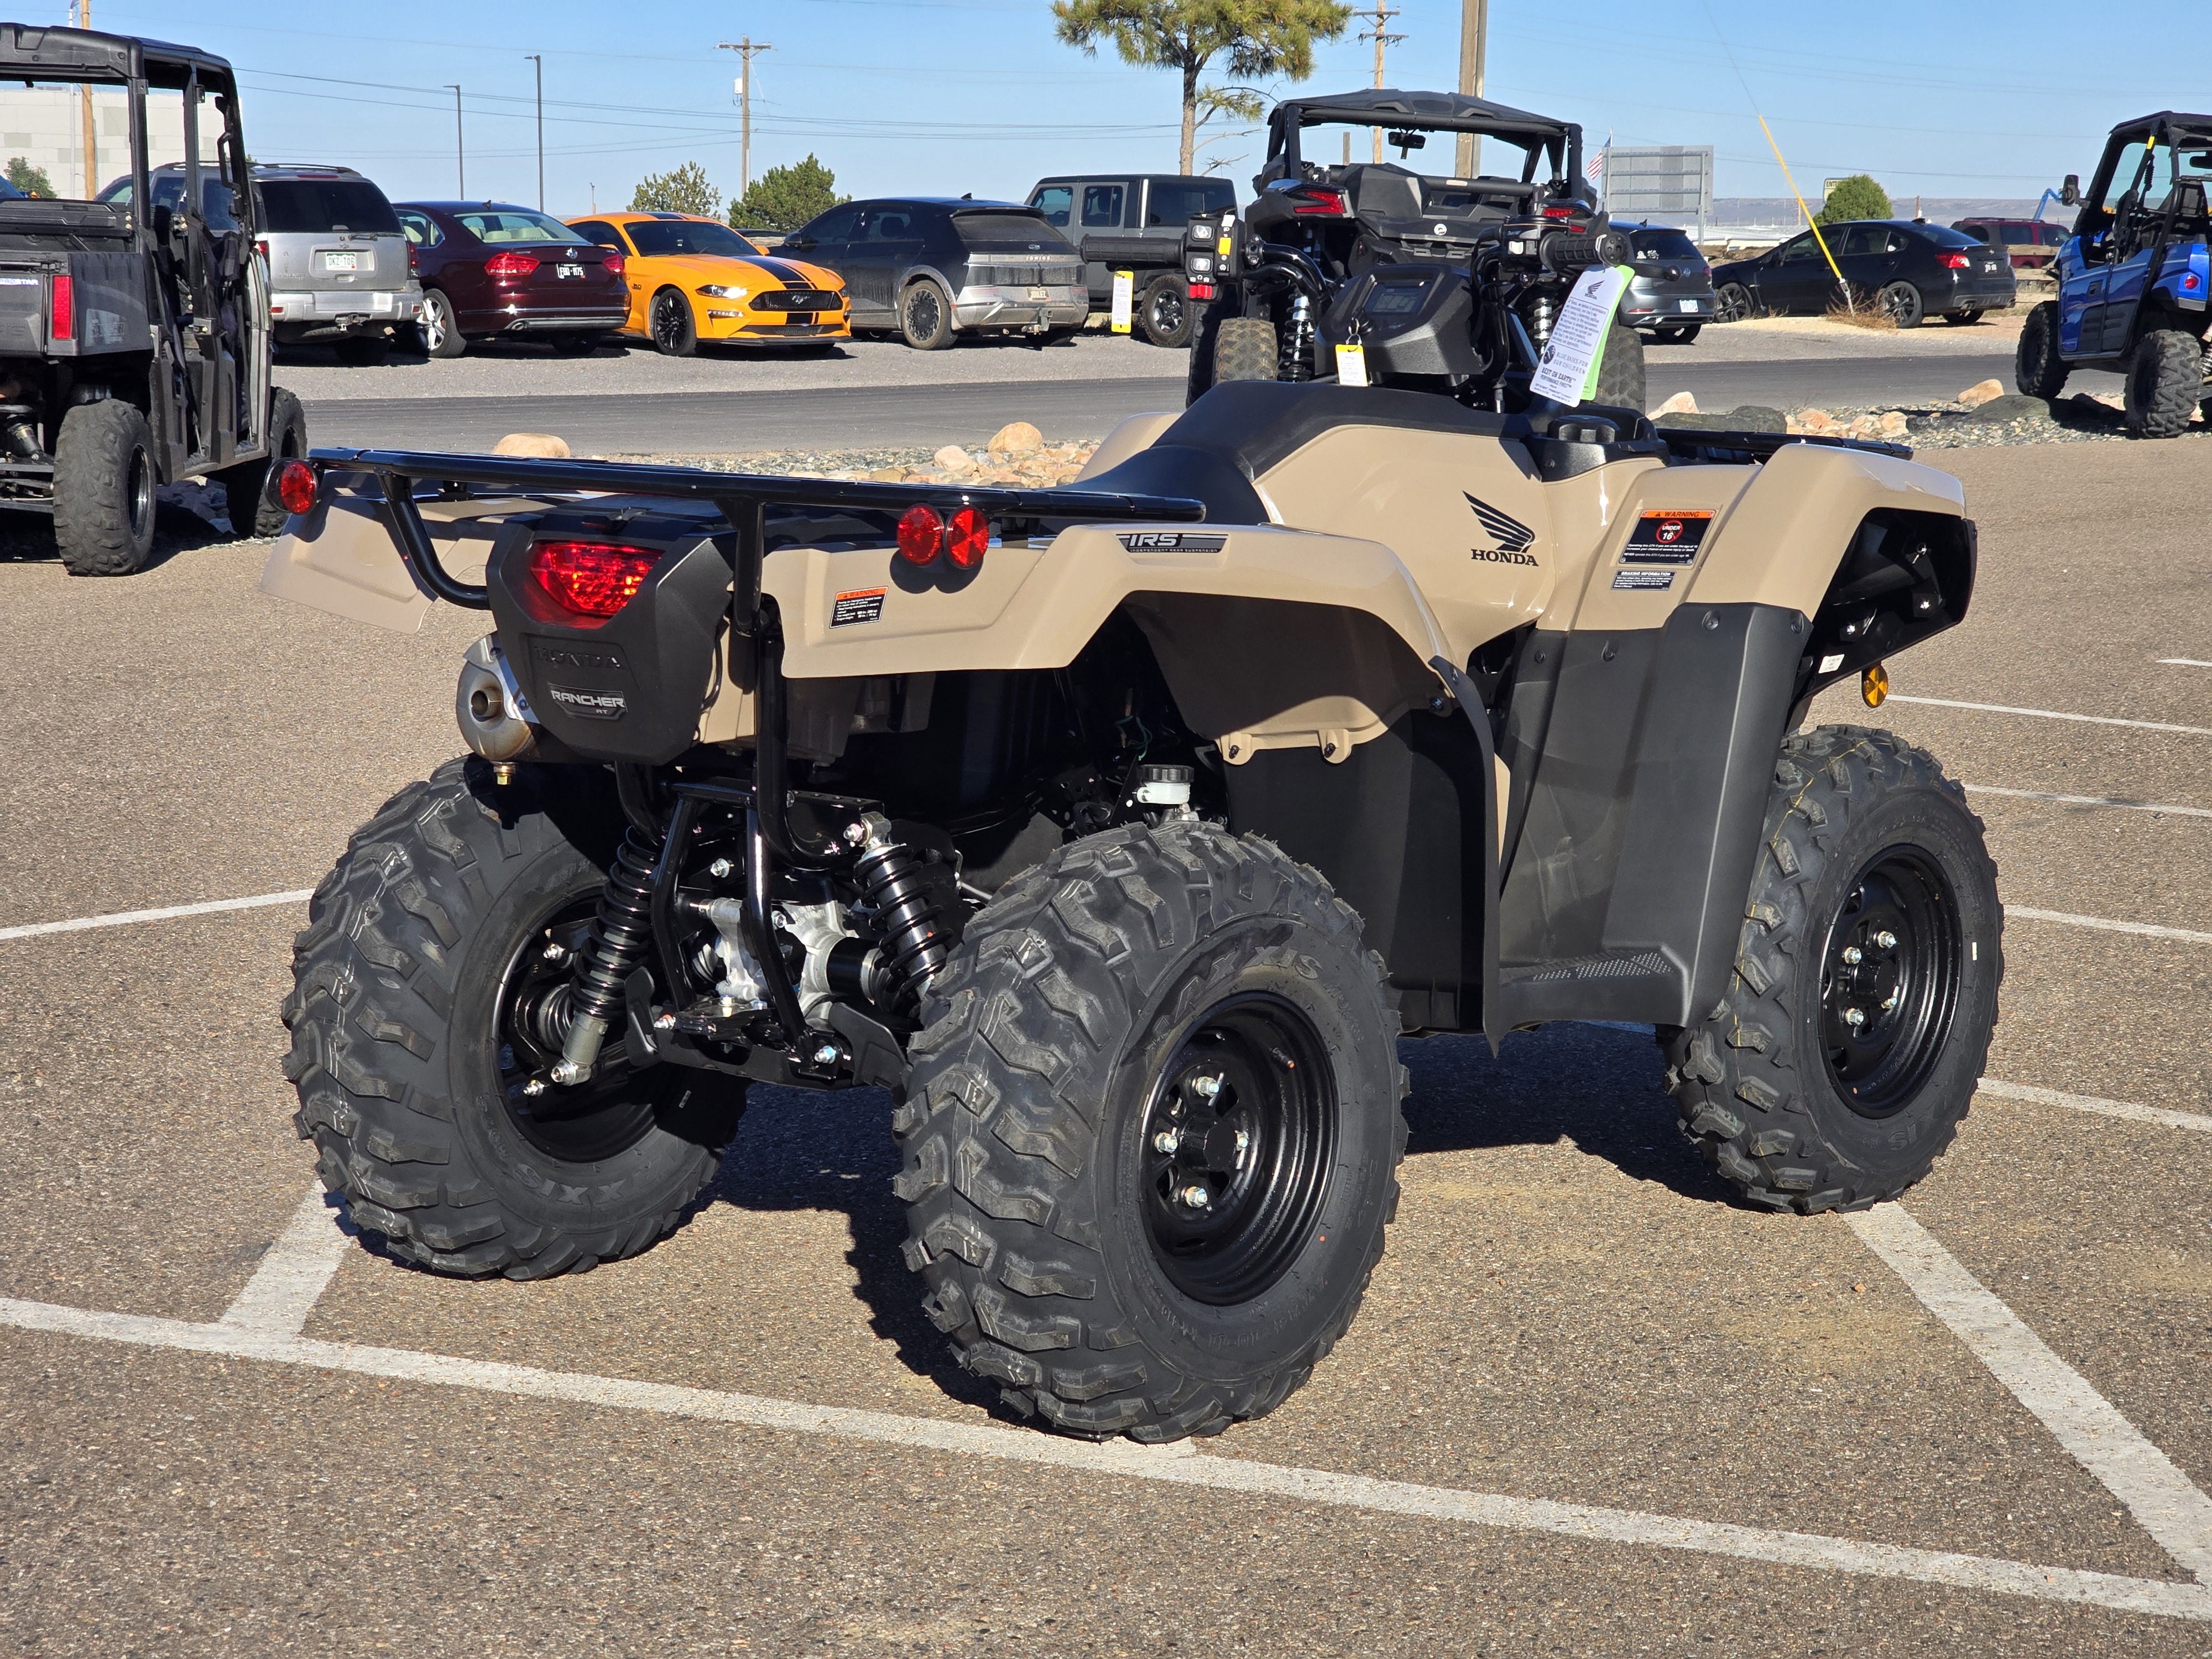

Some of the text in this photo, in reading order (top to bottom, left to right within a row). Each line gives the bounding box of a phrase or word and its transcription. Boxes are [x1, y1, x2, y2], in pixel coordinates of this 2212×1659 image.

[1129, 534, 1178, 546] IRS
[1662, 532, 1674, 540] 16
[1471, 549, 1539, 567] HONDA
[849, 588, 878, 597] WARNING
[551, 690, 625, 708] RANCHER
